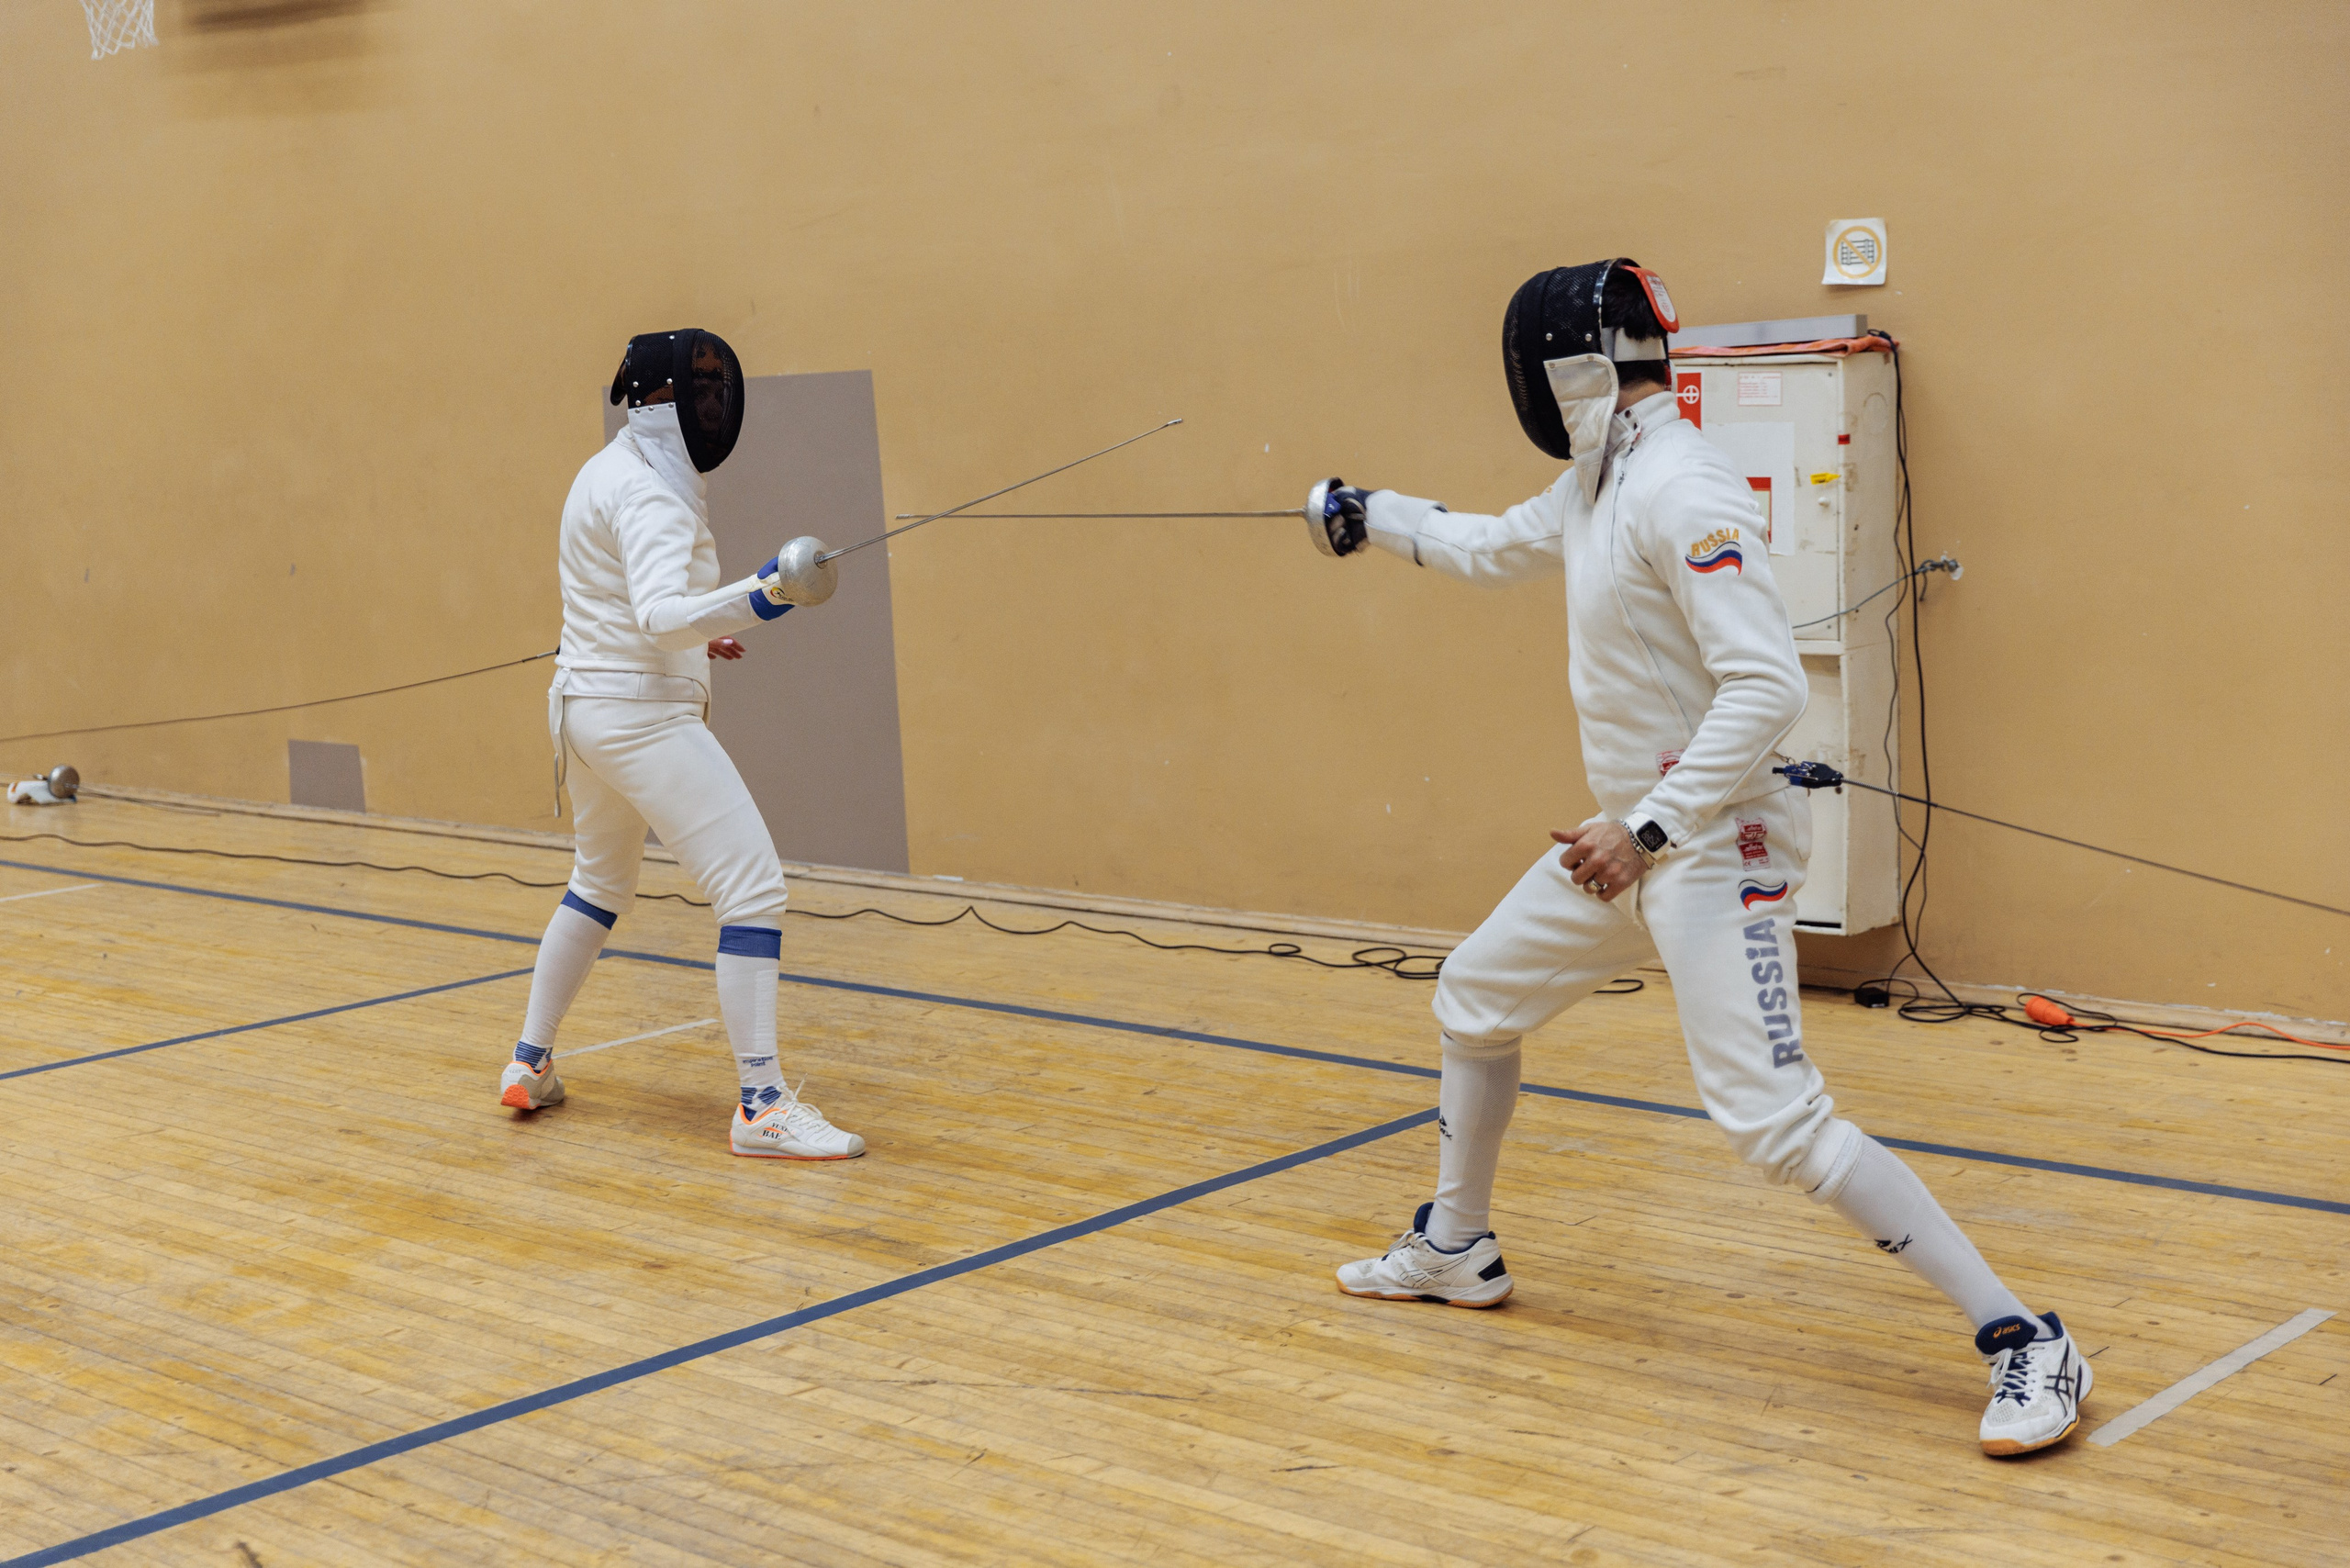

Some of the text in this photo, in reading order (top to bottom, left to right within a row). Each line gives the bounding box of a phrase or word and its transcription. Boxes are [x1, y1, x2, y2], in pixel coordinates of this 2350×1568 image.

[1691, 528, 1740, 556] RUSSIA
[1743, 918, 1804, 1069] RUSSIA
[762, 1129, 781, 1140] BAE
